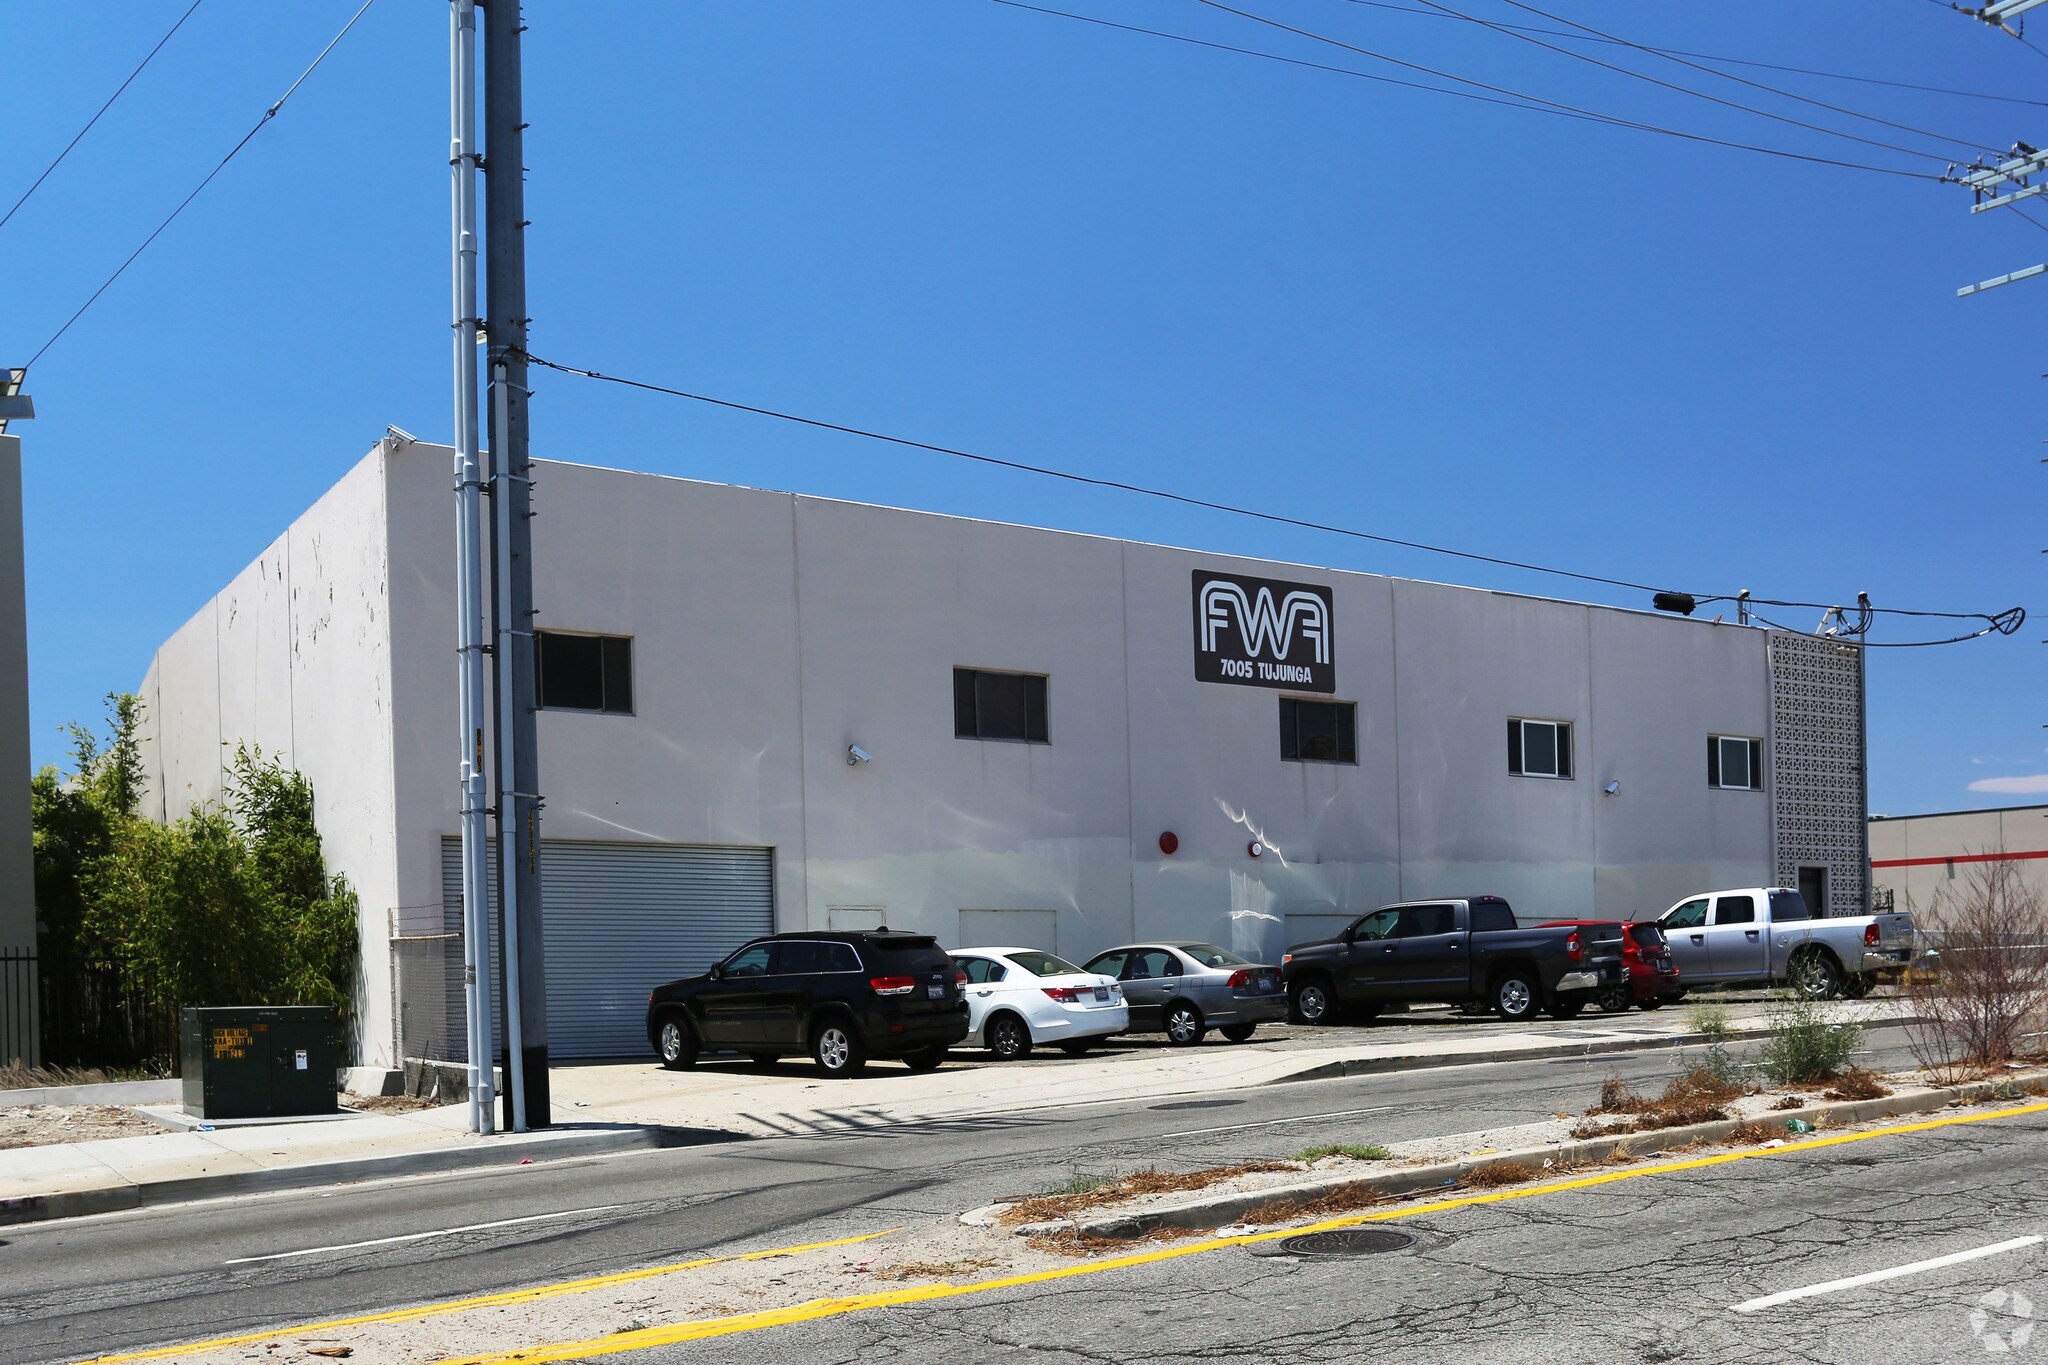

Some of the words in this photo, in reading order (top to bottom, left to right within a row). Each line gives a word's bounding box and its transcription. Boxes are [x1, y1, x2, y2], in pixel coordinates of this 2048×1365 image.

[1200, 580, 1330, 665] FWA
[1220, 659, 1253, 678] 7005
[1257, 662, 1313, 684] TUJUNGA
